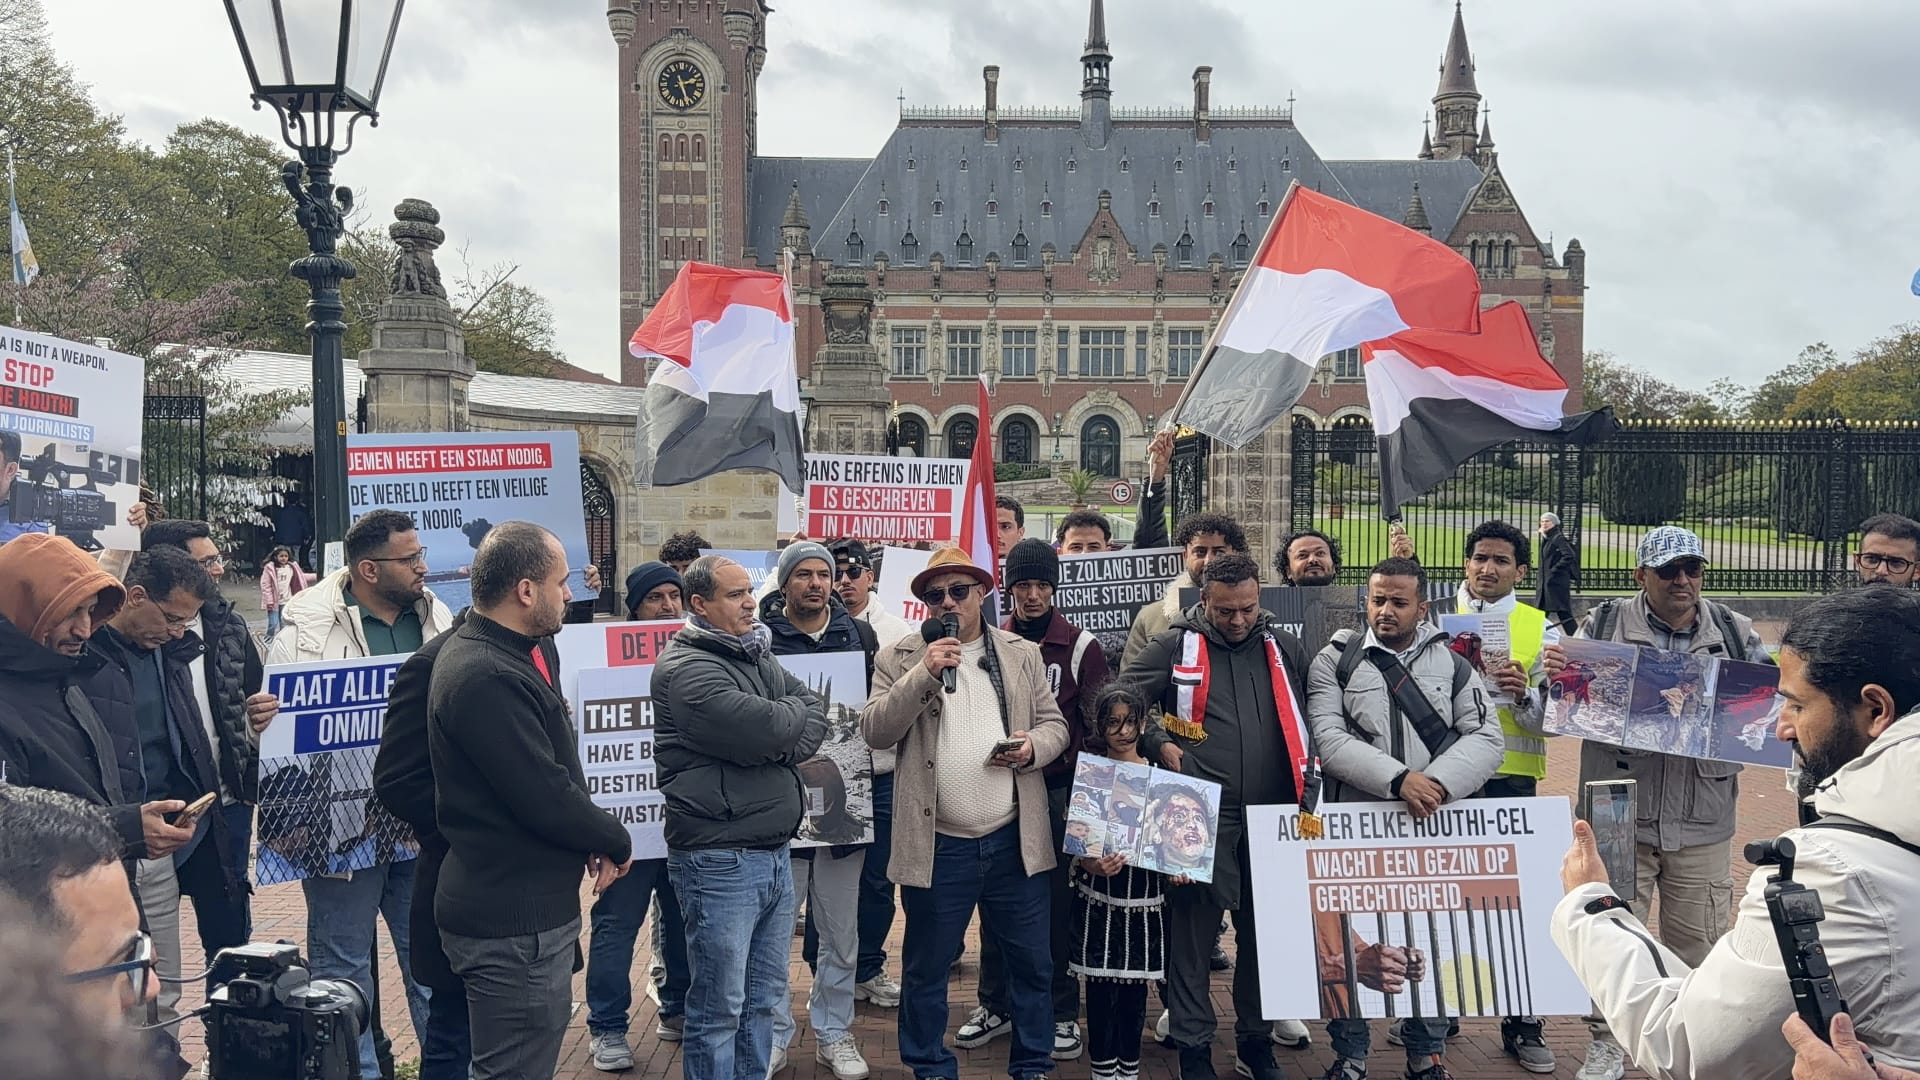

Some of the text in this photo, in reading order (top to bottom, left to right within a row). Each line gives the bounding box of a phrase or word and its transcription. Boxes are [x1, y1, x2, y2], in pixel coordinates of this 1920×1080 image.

[10, 338, 22, 353] IS
[26, 341, 49, 359] NOT
[51, 347, 58, 361] A
[61, 348, 109, 372] WEAPON.
[5, 358, 55, 388] STOP
[18, 389, 74, 416] HOUTHI
[12, 414, 91, 441] JOURNALISTS
[348, 447, 546, 471] JEMEN HEEFT EEN STAAT NODIG,
[844, 461, 904, 484] ERFENIS
[908, 463, 922, 484] IN
[925, 463, 963, 485] JEMEN
[350, 477, 549, 506] DE WERELD HEEFT EEN VEILIGE
[824, 486, 935, 511] IS GESCHREVEN
[1116, 488, 1128, 498] 15
[422, 508, 462, 530] NODIG
[822, 515, 935, 539] IN LANDMIJNEN
[1075, 558, 1132, 583] ZOLANG
[1135, 556, 1155, 578] DE
[1101, 583, 1151, 605] STEDEN
[622, 632, 648, 660] DE
[279, 673, 337, 709] LAAT
[586, 703, 633, 730] THE
[587, 743, 634, 764] HAVE
[1278, 807, 1534, 842] ACER ELKE HOUTHI-CEL
[1312, 846, 1510, 878] WACHT EEN GEZIN OP
[1315, 882, 1462, 912] GERECHTIGHEID
